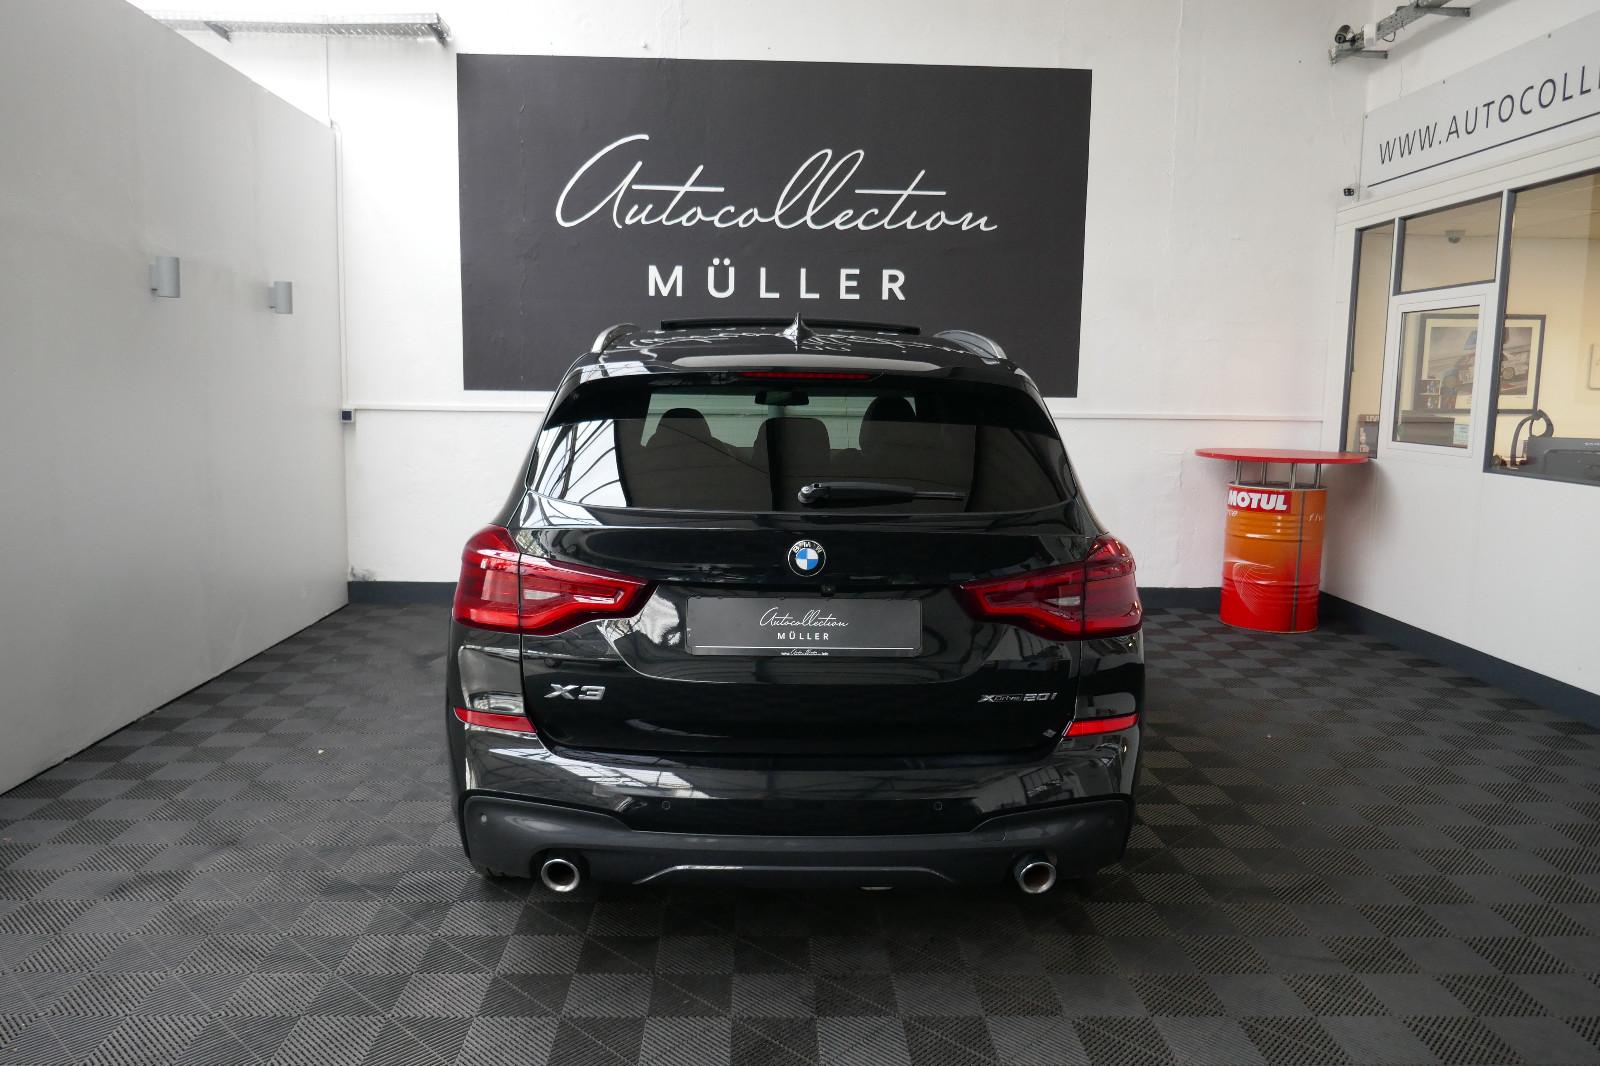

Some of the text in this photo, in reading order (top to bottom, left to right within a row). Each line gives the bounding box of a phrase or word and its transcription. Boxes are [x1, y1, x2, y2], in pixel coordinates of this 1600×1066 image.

[1379, 65, 1600, 165] WWW.AUTOCOLL
[555, 133, 998, 231] Autocollection
[647, 257, 906, 300] MÜLLER
[1227, 489, 1288, 511] MOTUL
[759, 606, 849, 627] Autocollection
[777, 631, 829, 640] MÜLLER
[544, 683, 605, 700] X3
